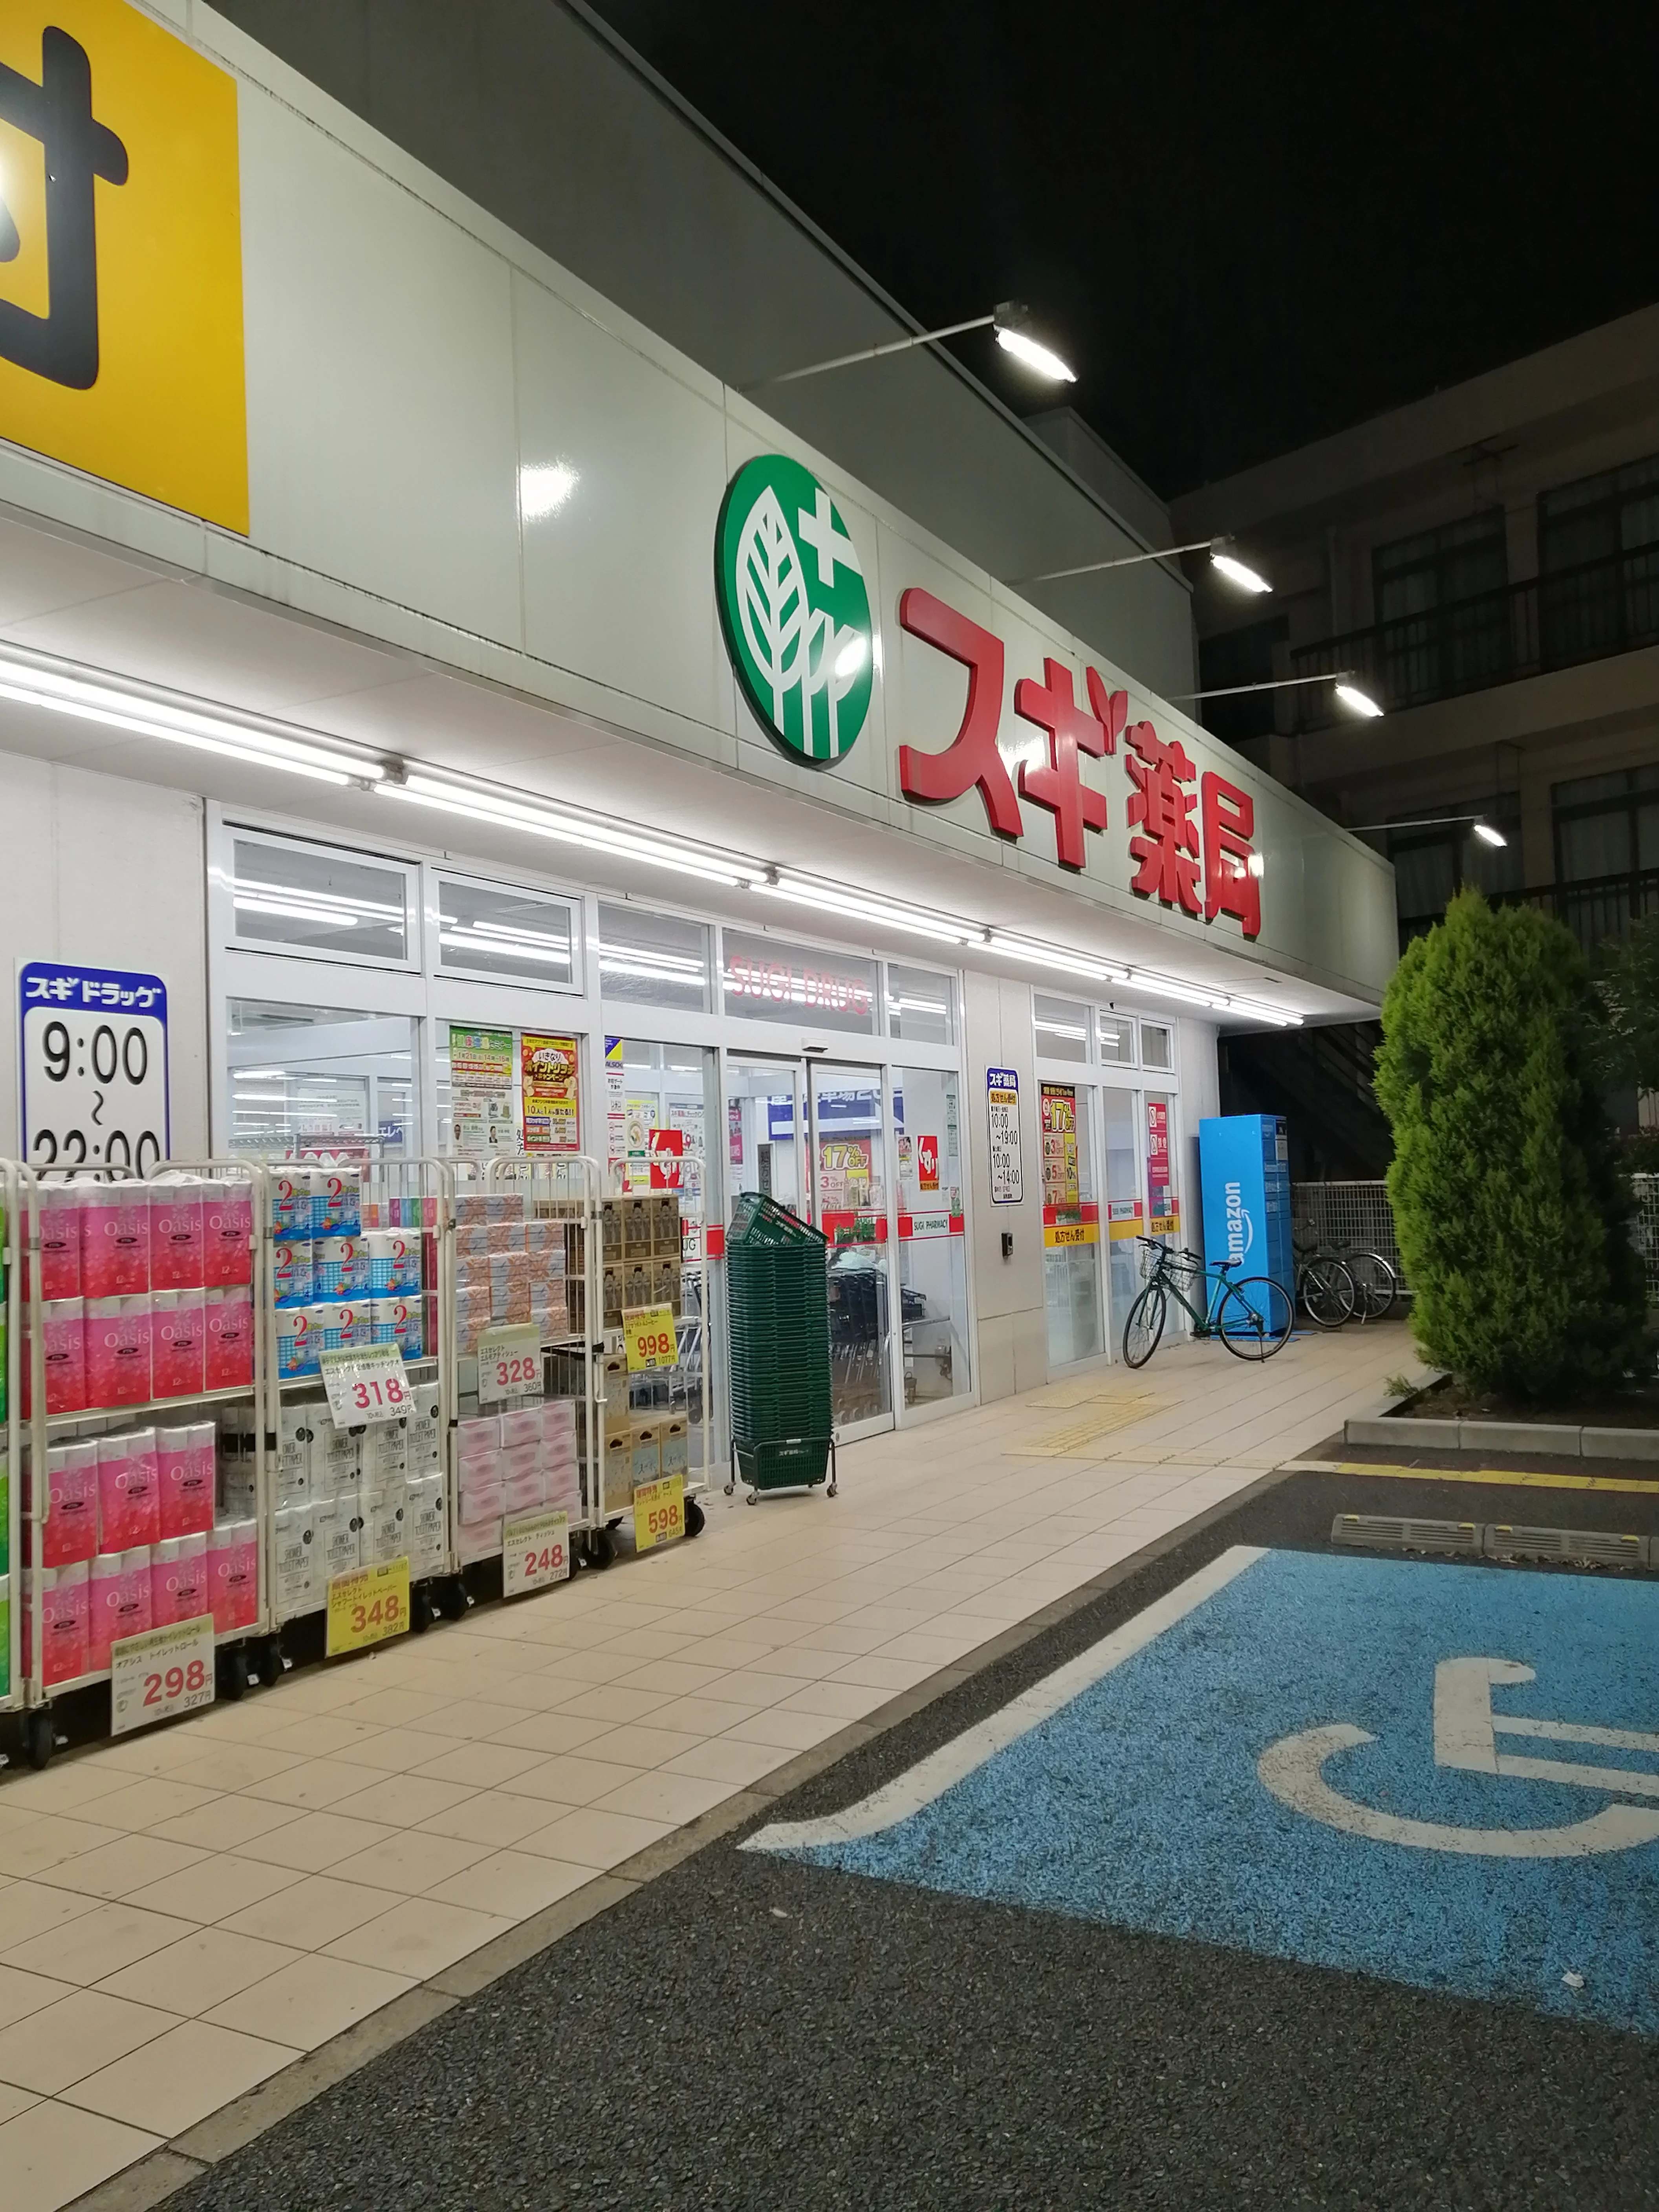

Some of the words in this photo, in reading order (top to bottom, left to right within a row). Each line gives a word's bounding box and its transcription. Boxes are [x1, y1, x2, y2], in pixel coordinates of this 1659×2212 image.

[899, 588, 1260, 939] スギ薬局
[730, 956, 791, 1003] SUGI
[804, 969, 868, 1014] DRUG
[42, 1021, 148, 1086] 9:00
[992, 1113, 1008, 1129] 10:00
[848, 1156, 867, 1168] OFF
[993, 1153, 1010, 1168] 10:00
[104, 1220, 148, 1238] Oasis
[159, 1216, 201, 1234] Oasis
[209, 1214, 251, 1230] Oasis
[914, 1220, 924, 1231] SUGI
[1225, 1181, 1244, 1264] amazon
[1055, 1229, 1084, 1243] 処方せん受付
[161, 1322, 203, 1340] Oasis
[209, 1315, 249, 1333] Oasis
[104, 1329, 149, 1348] Oasis
[115, 1467, 157, 1489] Oasis
[170, 1460, 213, 1481] Oasis
[49, 1482, 96, 1504] Oasis
[218, 1555, 256, 1578] Oasis
[166, 1570, 207, 1592] Oasis
[106, 1583, 150, 1607] Oasis
[42, 1599, 87, 1623] Oasis
[150, 1639, 199, 1661] トイレットロール
